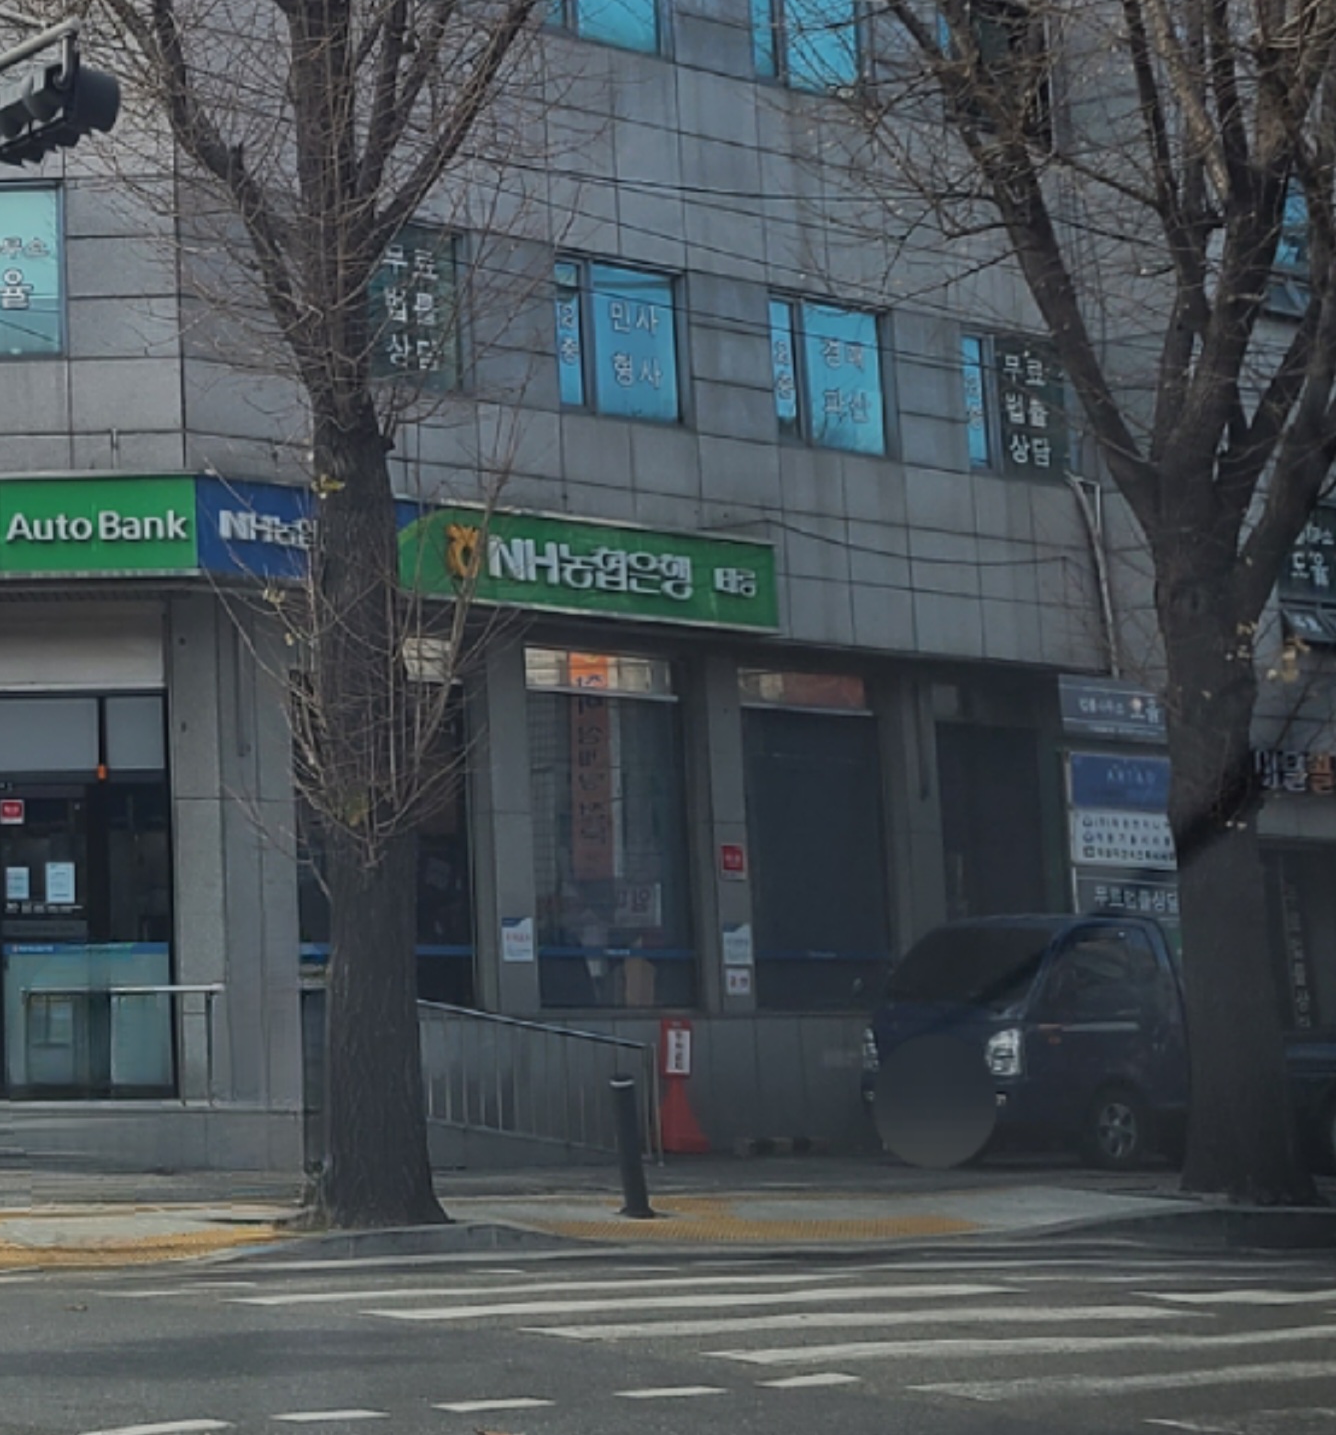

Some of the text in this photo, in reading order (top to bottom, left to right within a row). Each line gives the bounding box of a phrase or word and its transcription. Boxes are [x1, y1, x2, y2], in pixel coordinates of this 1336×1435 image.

[609, 301, 659, 337] 민사
[613, 351, 663, 390] 형사
[1002, 354, 1046, 386] 무료
[1010, 433, 1051, 467] 상담
[6, 509, 94, 542] Auto
[98, 508, 188, 541] Bank
[488, 536, 694, 601] NH농협은행
